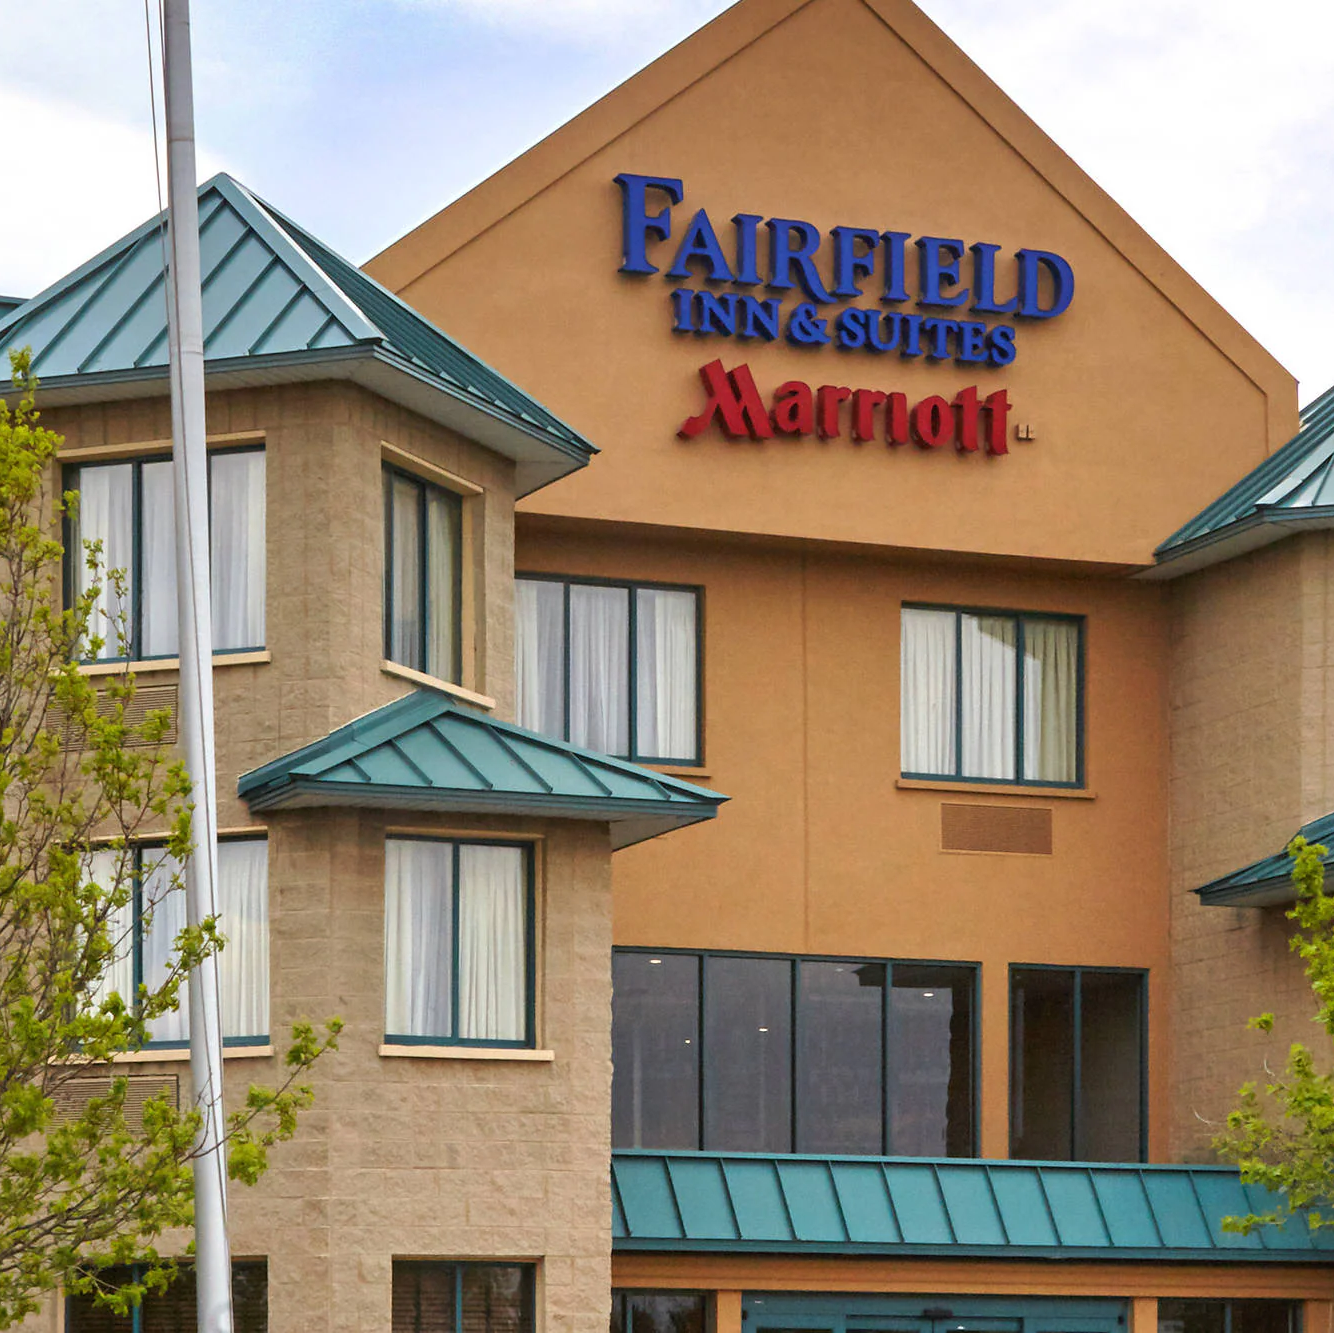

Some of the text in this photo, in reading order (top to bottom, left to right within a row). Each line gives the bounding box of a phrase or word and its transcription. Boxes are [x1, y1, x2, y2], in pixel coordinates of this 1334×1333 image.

[613, 173, 1075, 320] FAIRFIELD
[671, 288, 1017, 367] INN & SUITES
[676, 358, 1012, 456] Marriott
